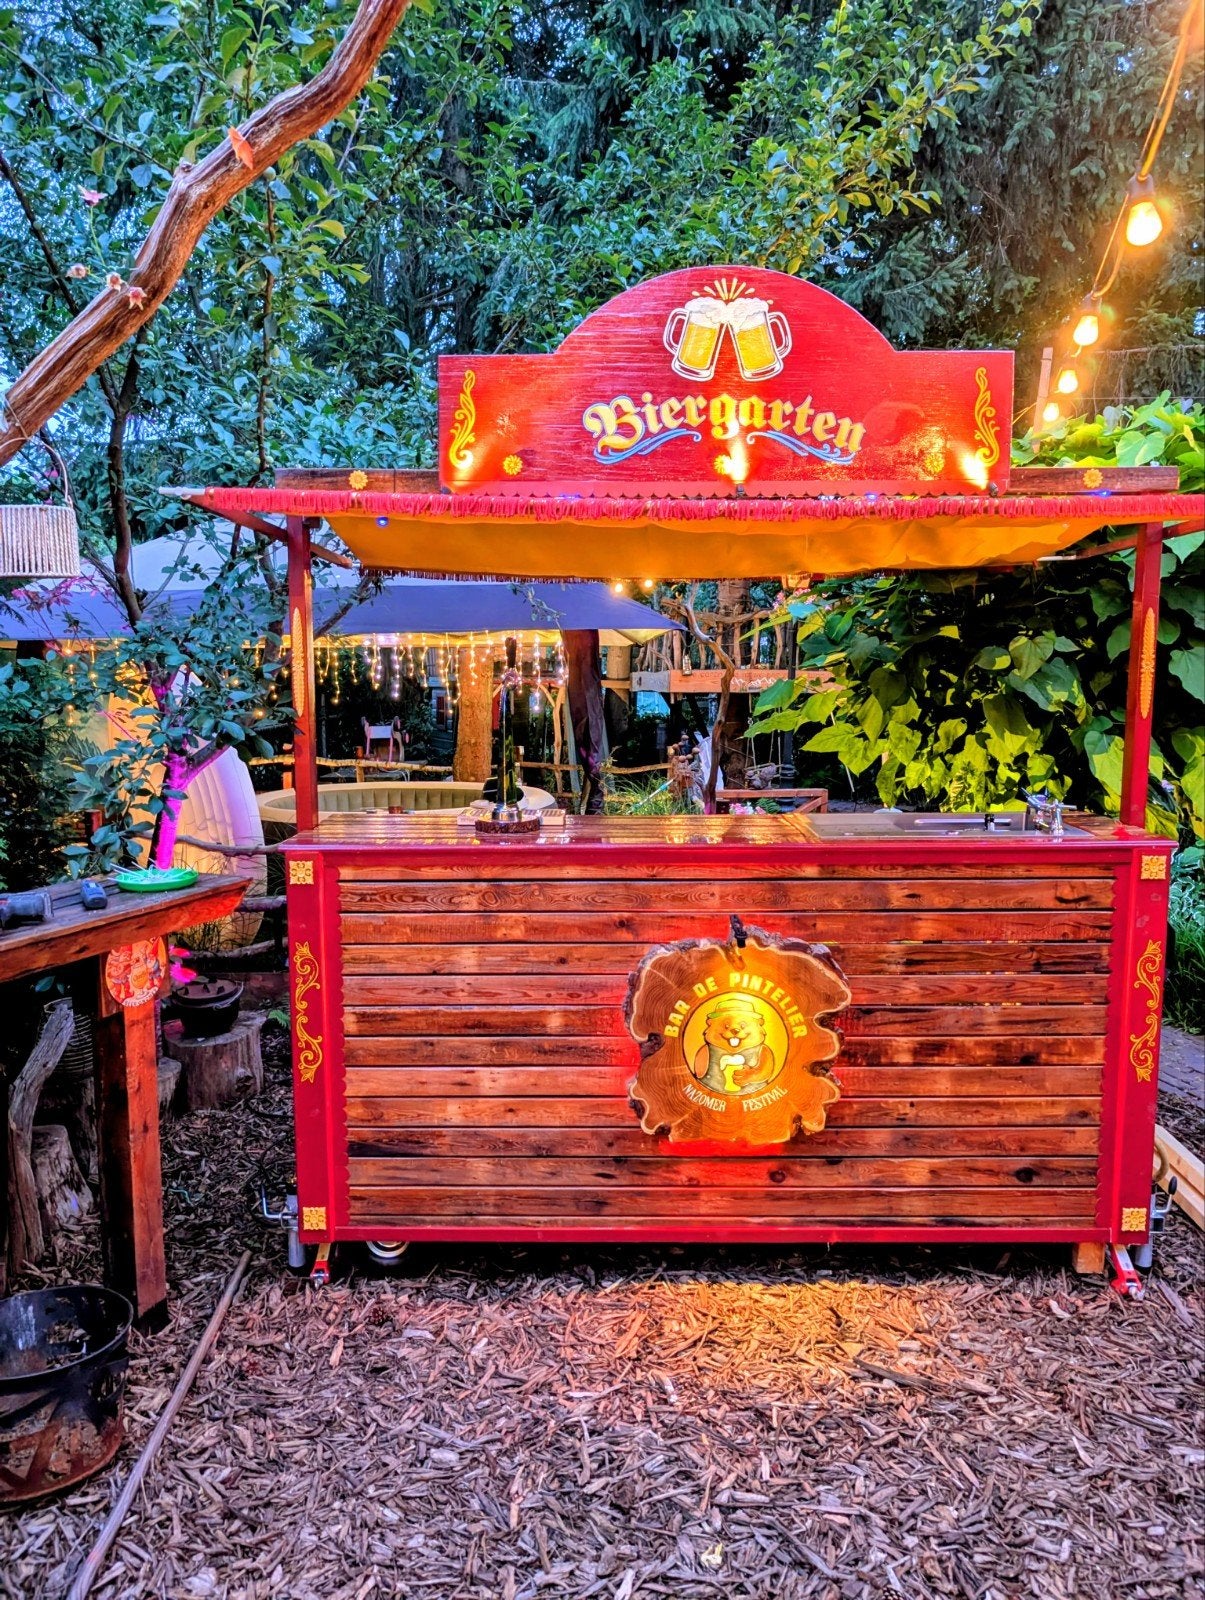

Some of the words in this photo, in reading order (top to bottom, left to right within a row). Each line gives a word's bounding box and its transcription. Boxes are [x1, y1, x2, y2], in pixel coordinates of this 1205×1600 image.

[583, 392, 866, 453] Biergarten
[664, 1000, 691, 1038] BAR
[693, 976, 718, 998] DE
[729, 973, 808, 1039] PINTELIER
[683, 1083, 726, 1112] NAZOMER
[742, 1086, 788, 1112] FESTIVAL
